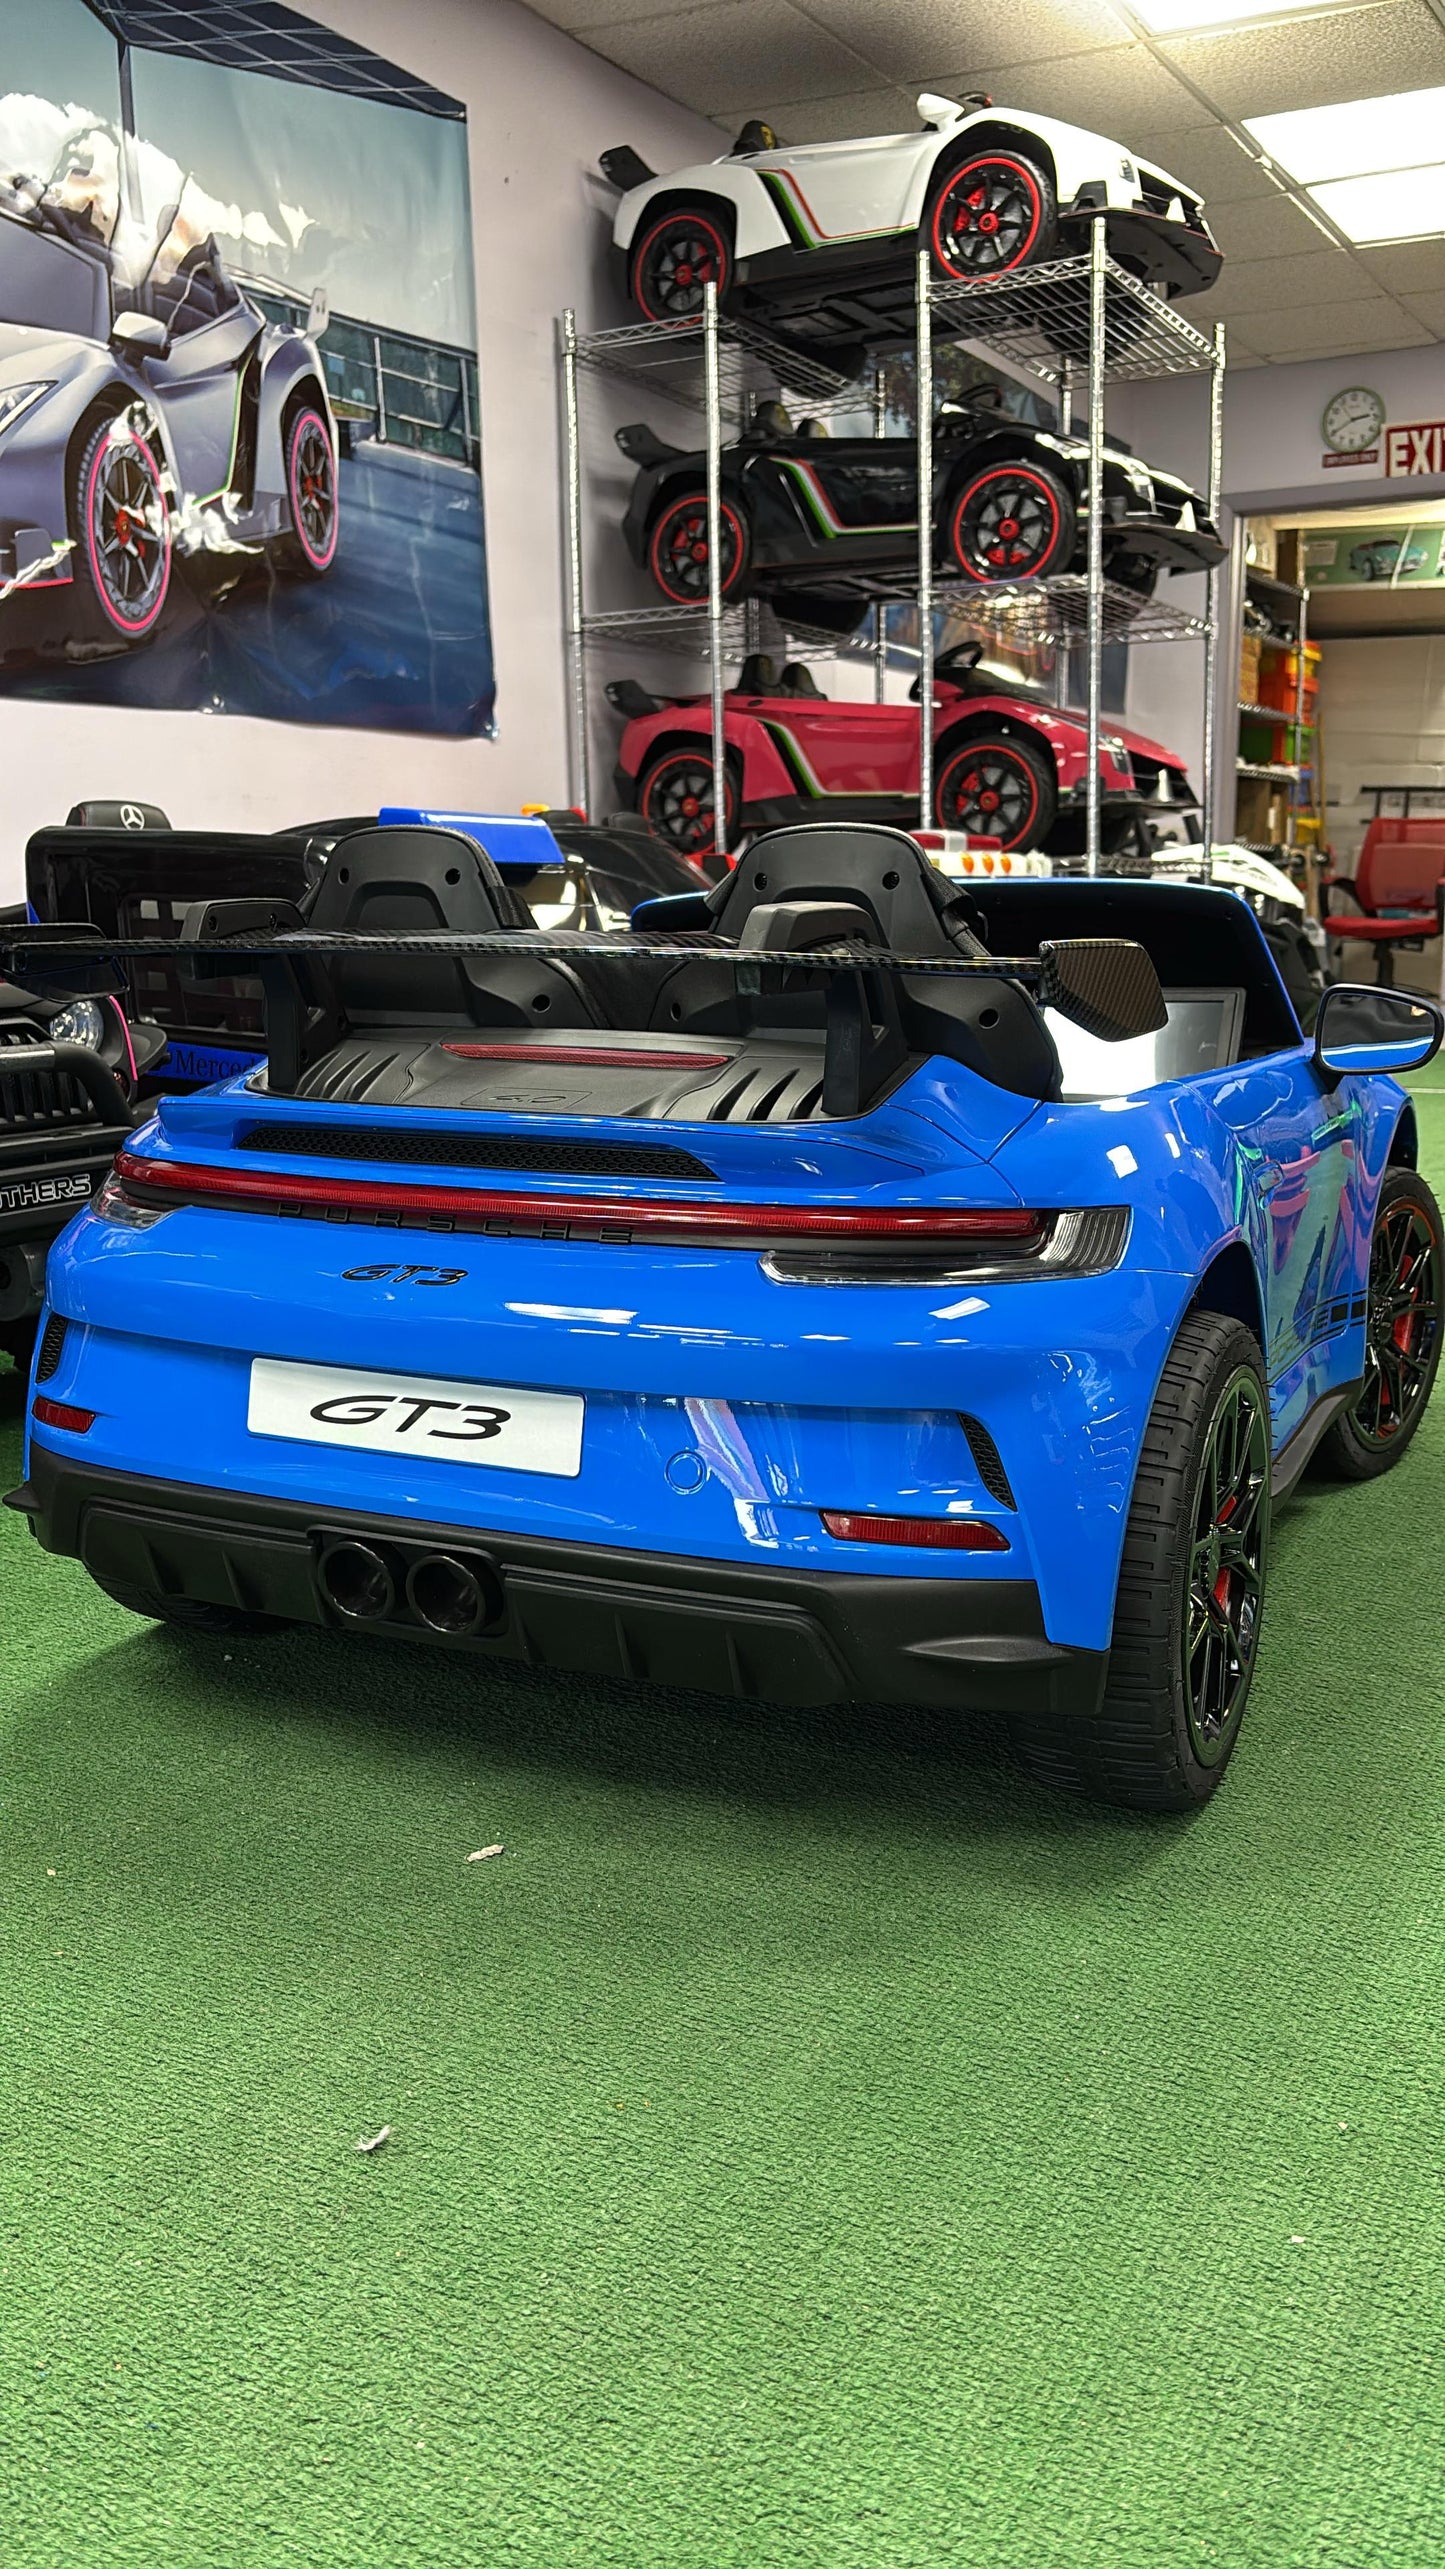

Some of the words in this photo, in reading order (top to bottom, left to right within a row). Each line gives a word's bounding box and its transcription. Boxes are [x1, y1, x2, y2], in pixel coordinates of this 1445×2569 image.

[1389, 427, 1445, 478] EXI
[0, 1173, 92, 1208] THERS
[277, 1201, 633, 1244] PORSCHE
[341, 1263, 469, 1286] GT3
[309, 1395, 512, 1440] GT3
